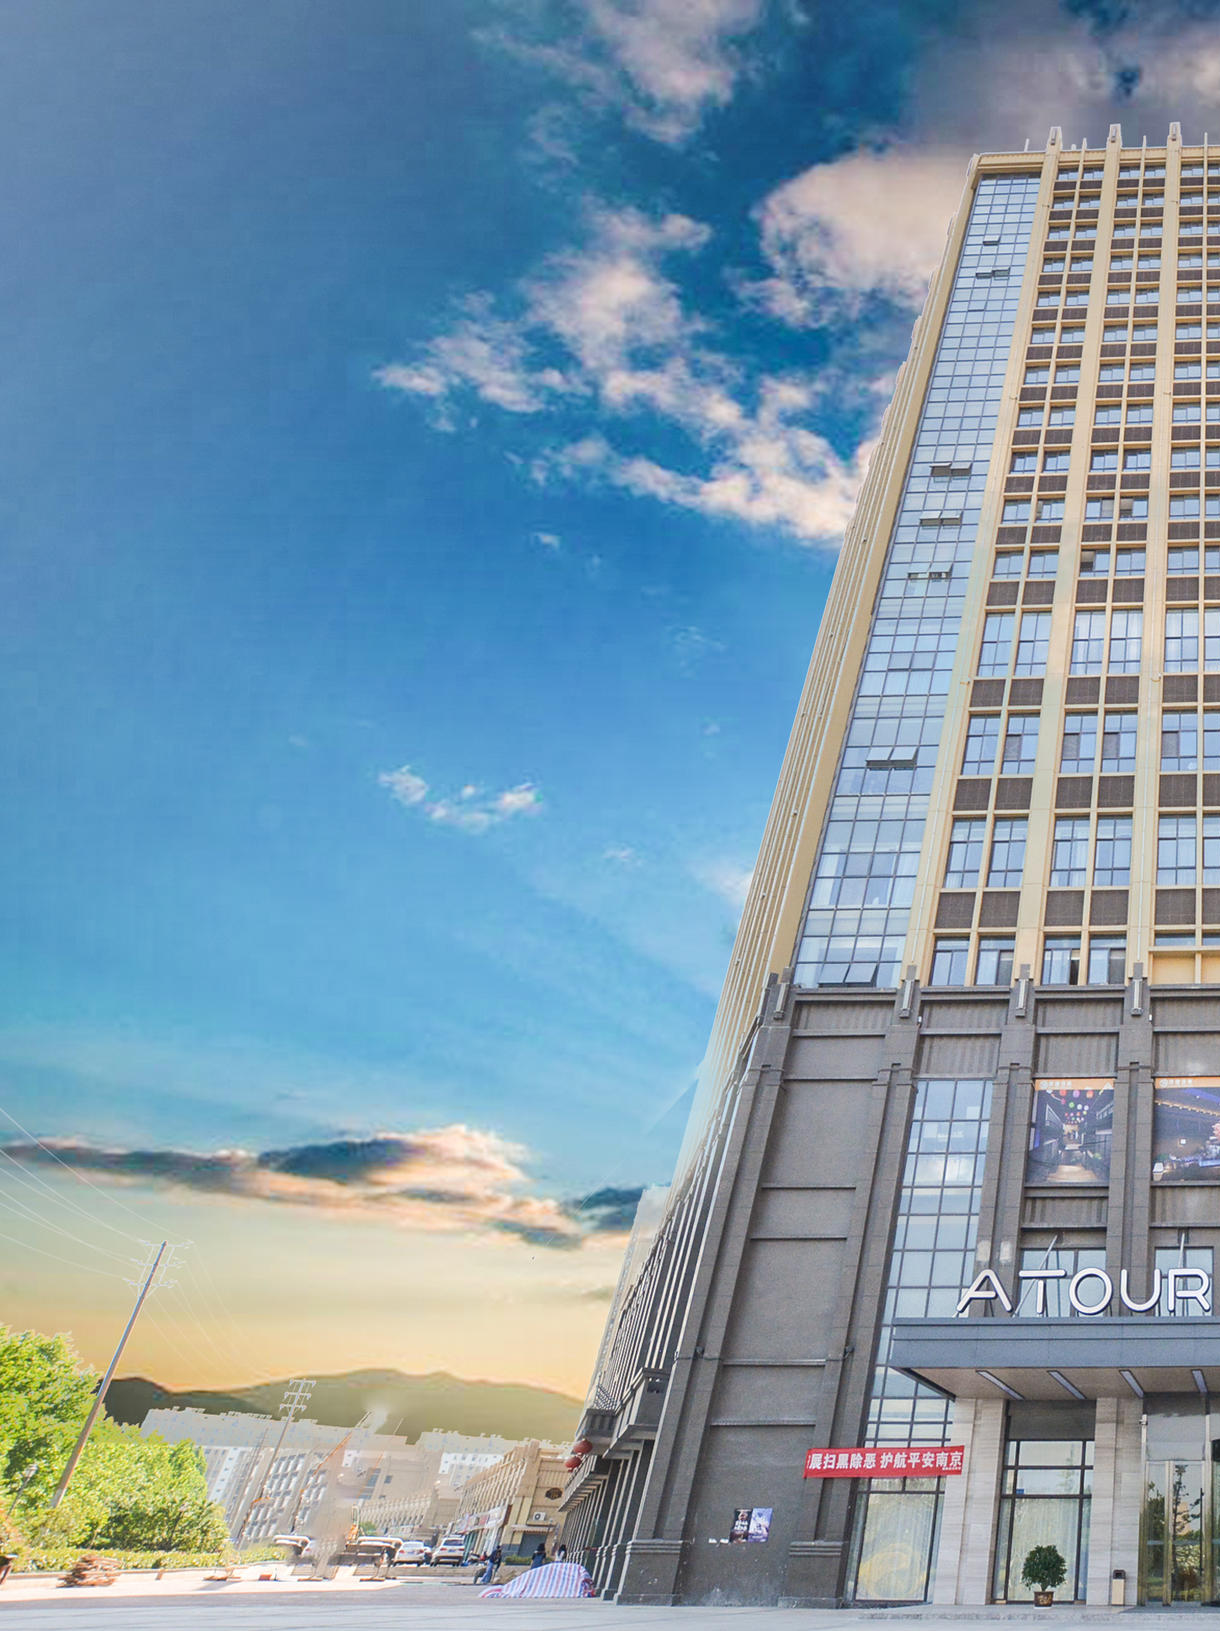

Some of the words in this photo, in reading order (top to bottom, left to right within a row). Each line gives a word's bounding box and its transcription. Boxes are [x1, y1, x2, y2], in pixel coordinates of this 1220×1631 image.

[956, 1268, 1211, 1315] ATOUR
[807, 1452, 876, 1469] 展扫黑除恶
